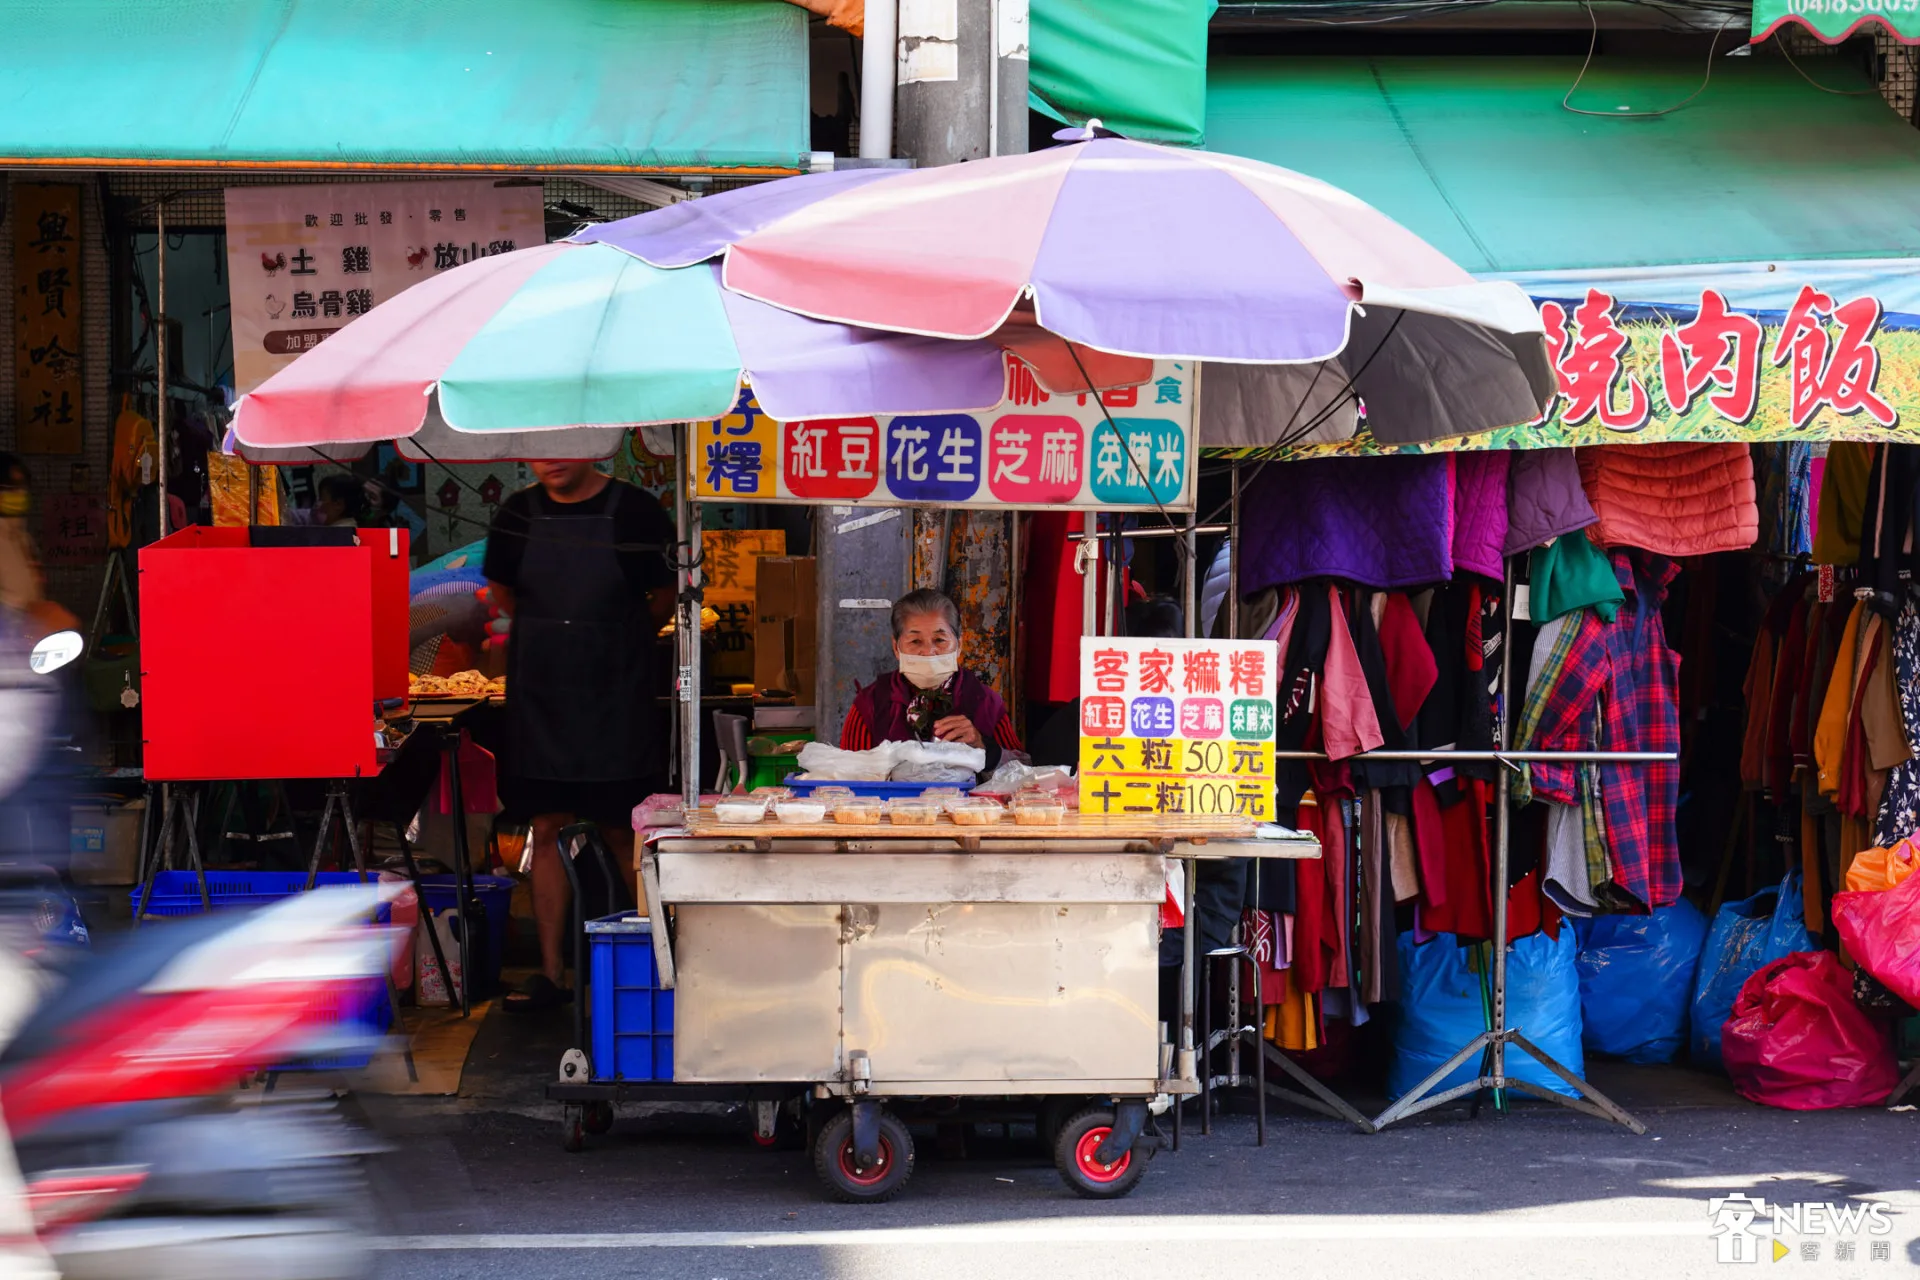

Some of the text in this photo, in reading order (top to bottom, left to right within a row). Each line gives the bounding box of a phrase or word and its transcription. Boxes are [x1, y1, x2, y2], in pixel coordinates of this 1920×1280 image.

[285, 333, 332, 350] 加盟
[1531, 284, 1900, 430] 燒肉飯
[790, 426, 874, 479] 紅豆
[890, 425, 976, 484] 花生
[994, 426, 1078, 486] 芝麻
[1084, 702, 1123, 729] 紅豆
[1132, 702, 1173, 730] 花生
[1182, 704, 1222, 731] 芝麻
